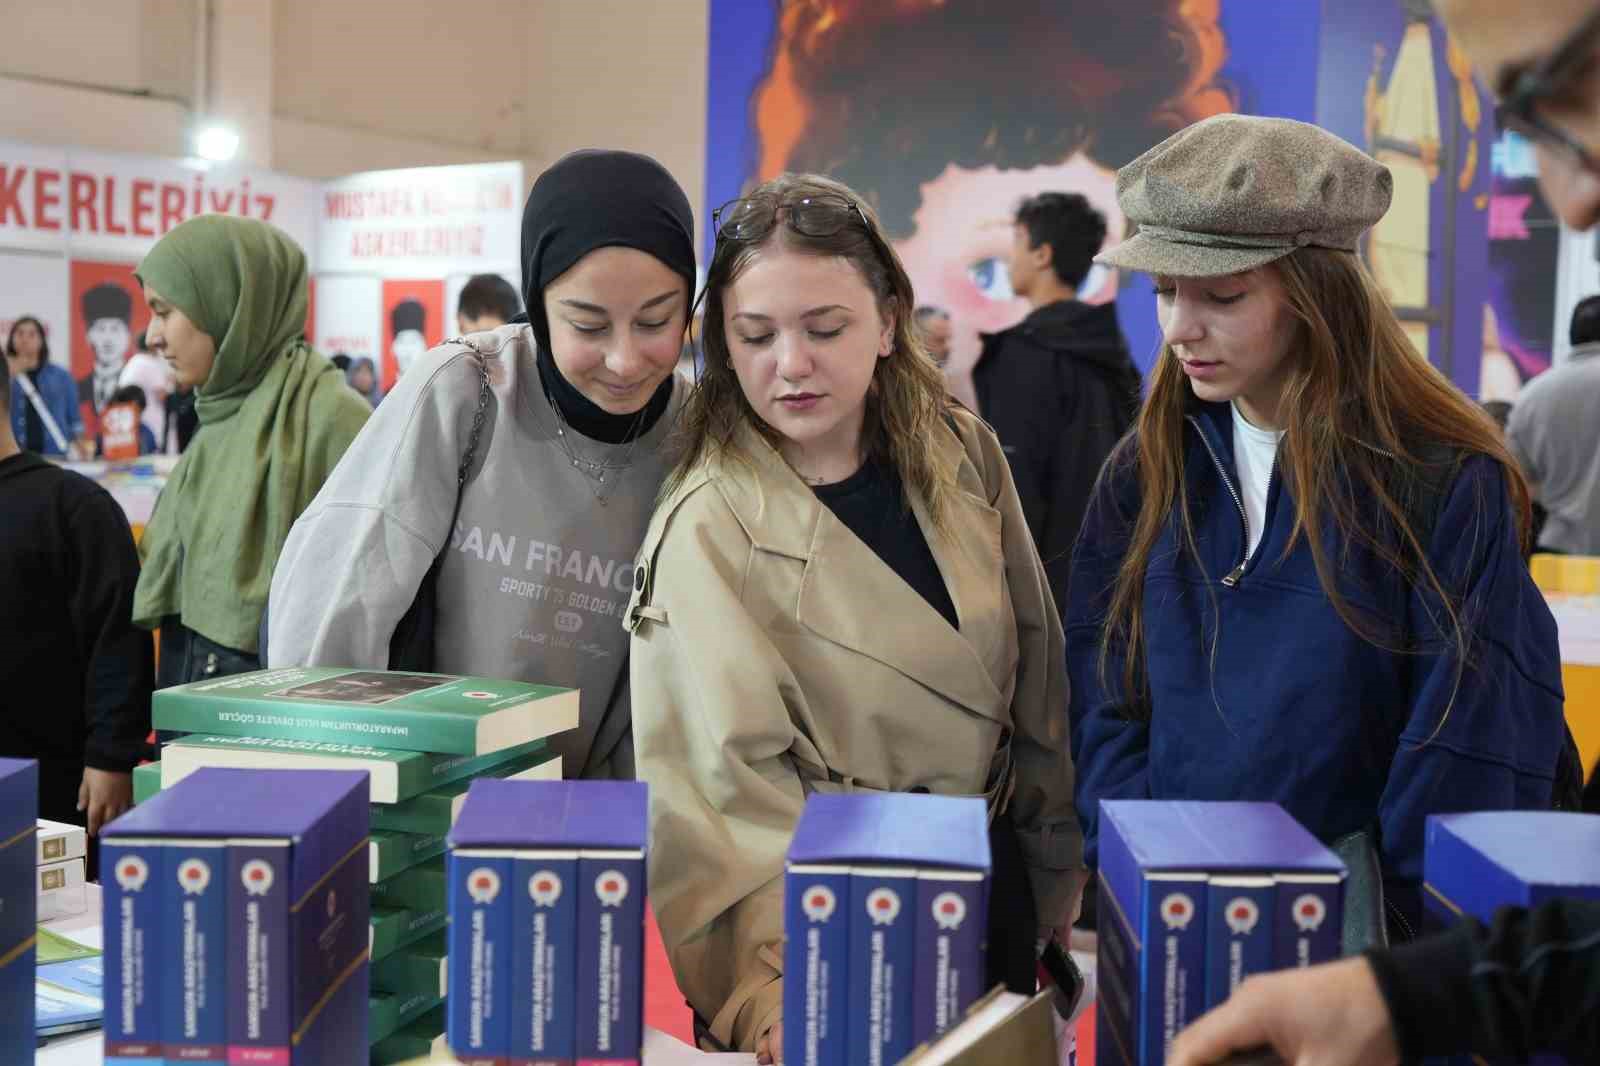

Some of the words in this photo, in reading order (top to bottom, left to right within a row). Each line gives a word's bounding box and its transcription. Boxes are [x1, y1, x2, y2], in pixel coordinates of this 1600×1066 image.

[499, 576, 550, 601] SPORTY
[567, 591, 617, 616] GOLDEN
[218, 711, 252, 724] GÖÇLER
[870, 1023, 882, 1066] AMSUN
